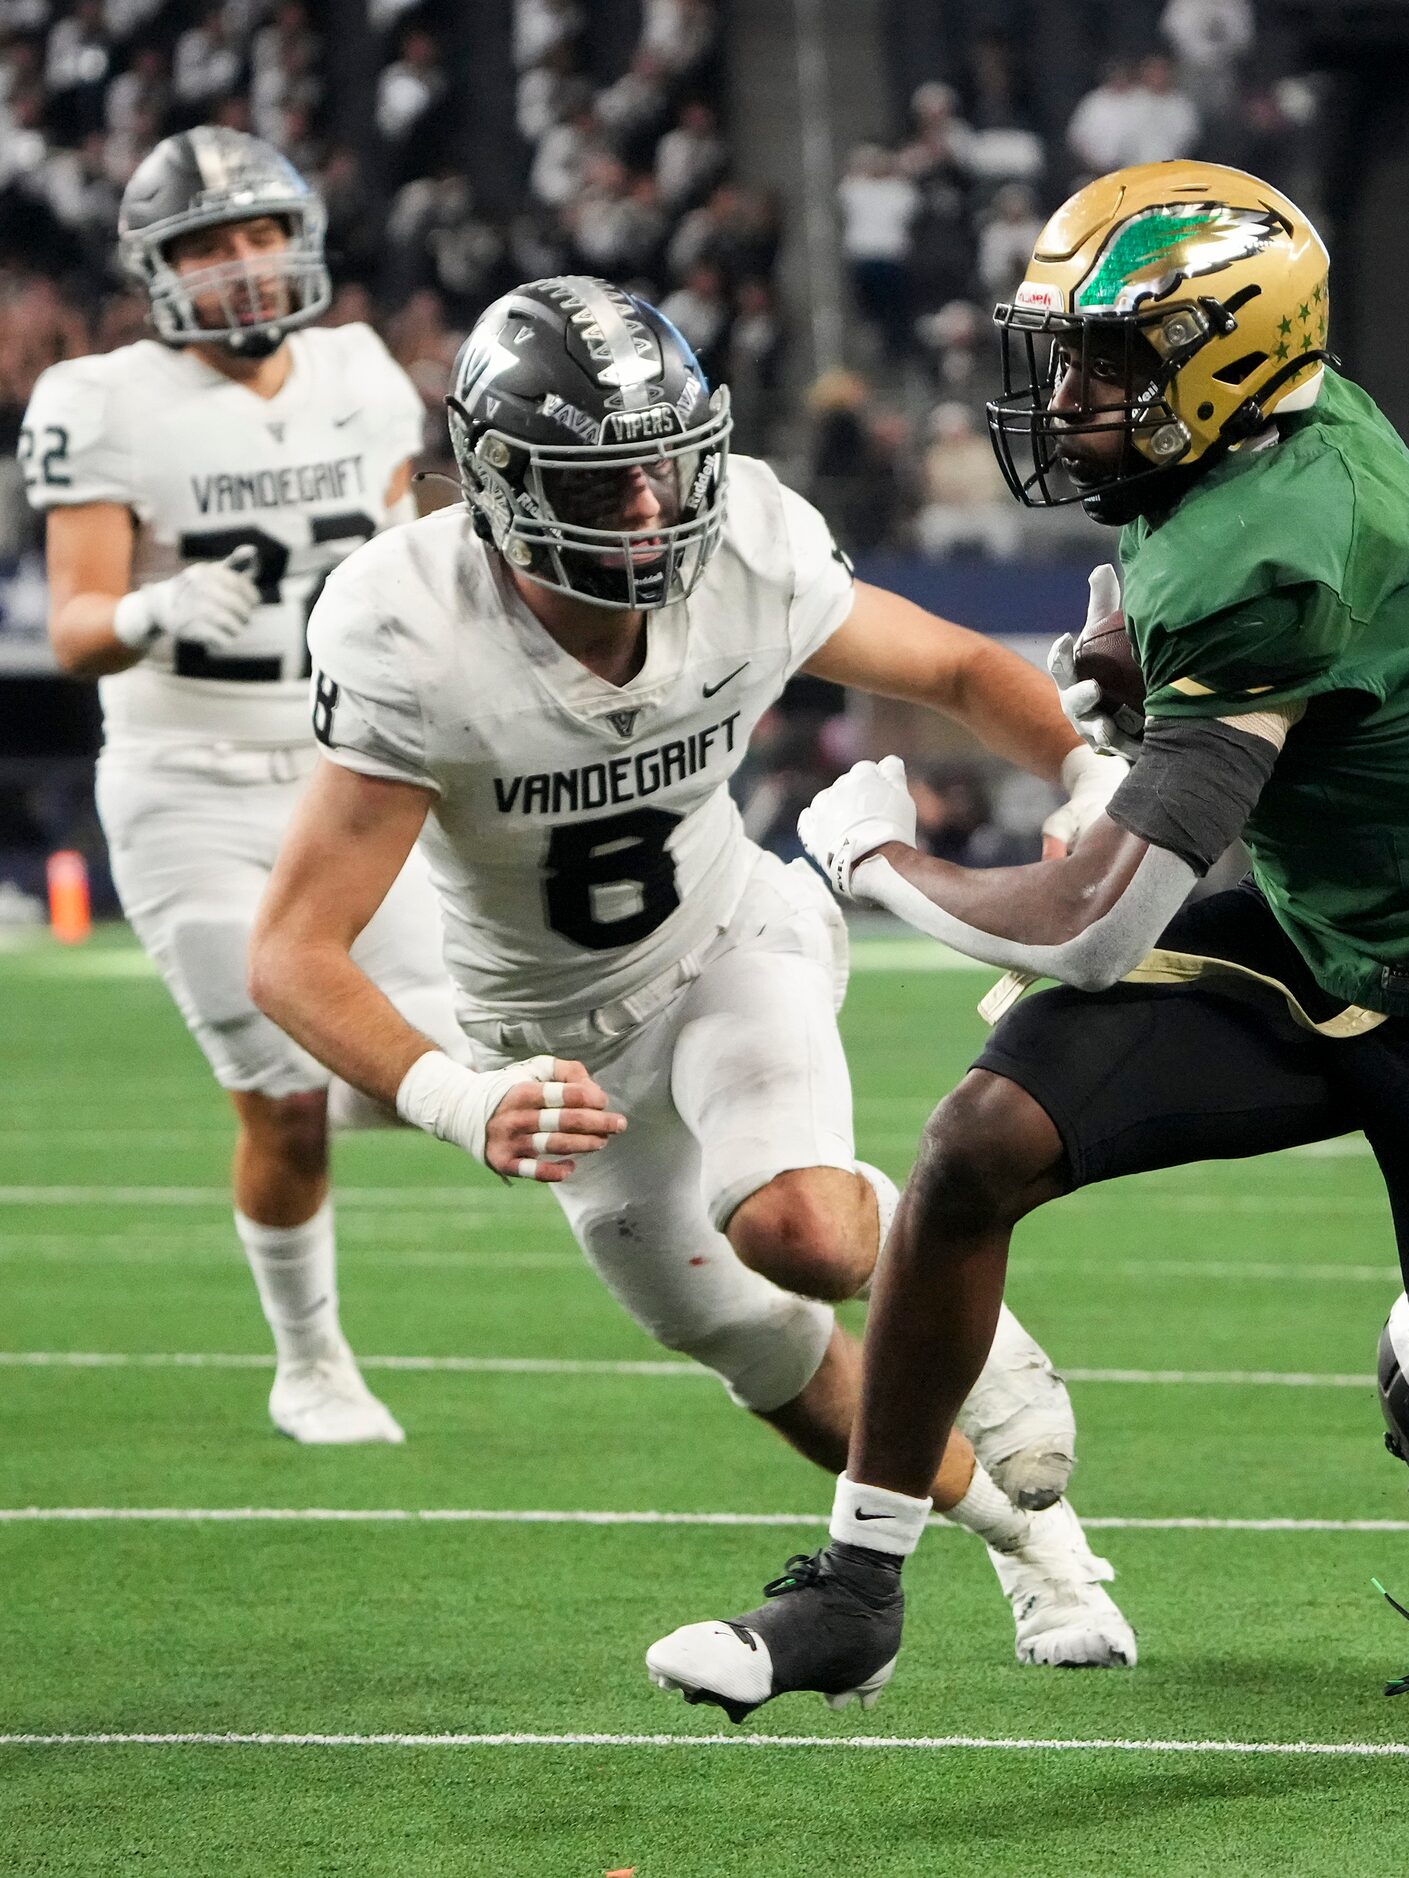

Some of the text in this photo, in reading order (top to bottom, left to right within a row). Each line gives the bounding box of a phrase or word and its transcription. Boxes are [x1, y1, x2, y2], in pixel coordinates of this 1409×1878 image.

[610, 407, 674, 440] VIPERS
[190, 455, 366, 514] VANDEGRIFT
[686, 454, 717, 509] Riddell
[312, 669, 339, 748] 8
[493, 711, 741, 814] VANDEGRIFT
[540, 805, 685, 950] 8
